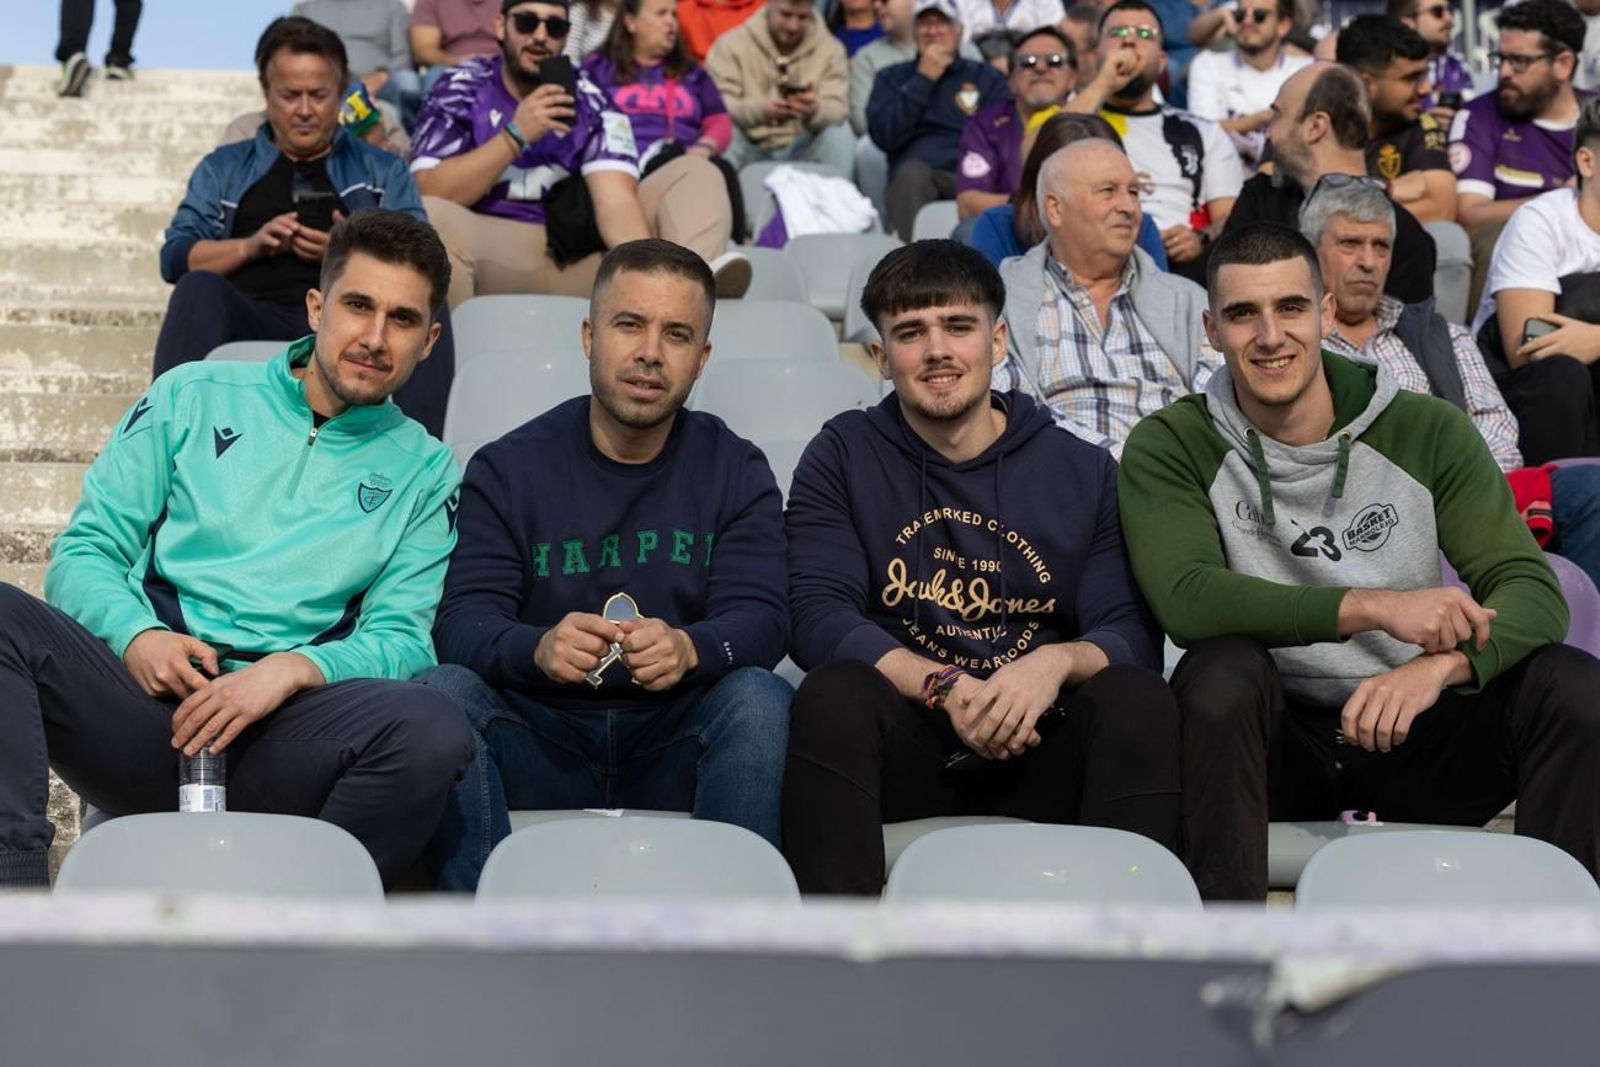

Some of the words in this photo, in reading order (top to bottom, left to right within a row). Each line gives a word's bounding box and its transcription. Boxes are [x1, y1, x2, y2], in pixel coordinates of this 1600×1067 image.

[896, 507, 982, 546] TRAEMRKED
[1347, 507, 1391, 540] BASKET
[933, 546, 966, 570] SINE
[902, 617, 947, 659] JEANS
[954, 654, 1003, 670] WEAR
